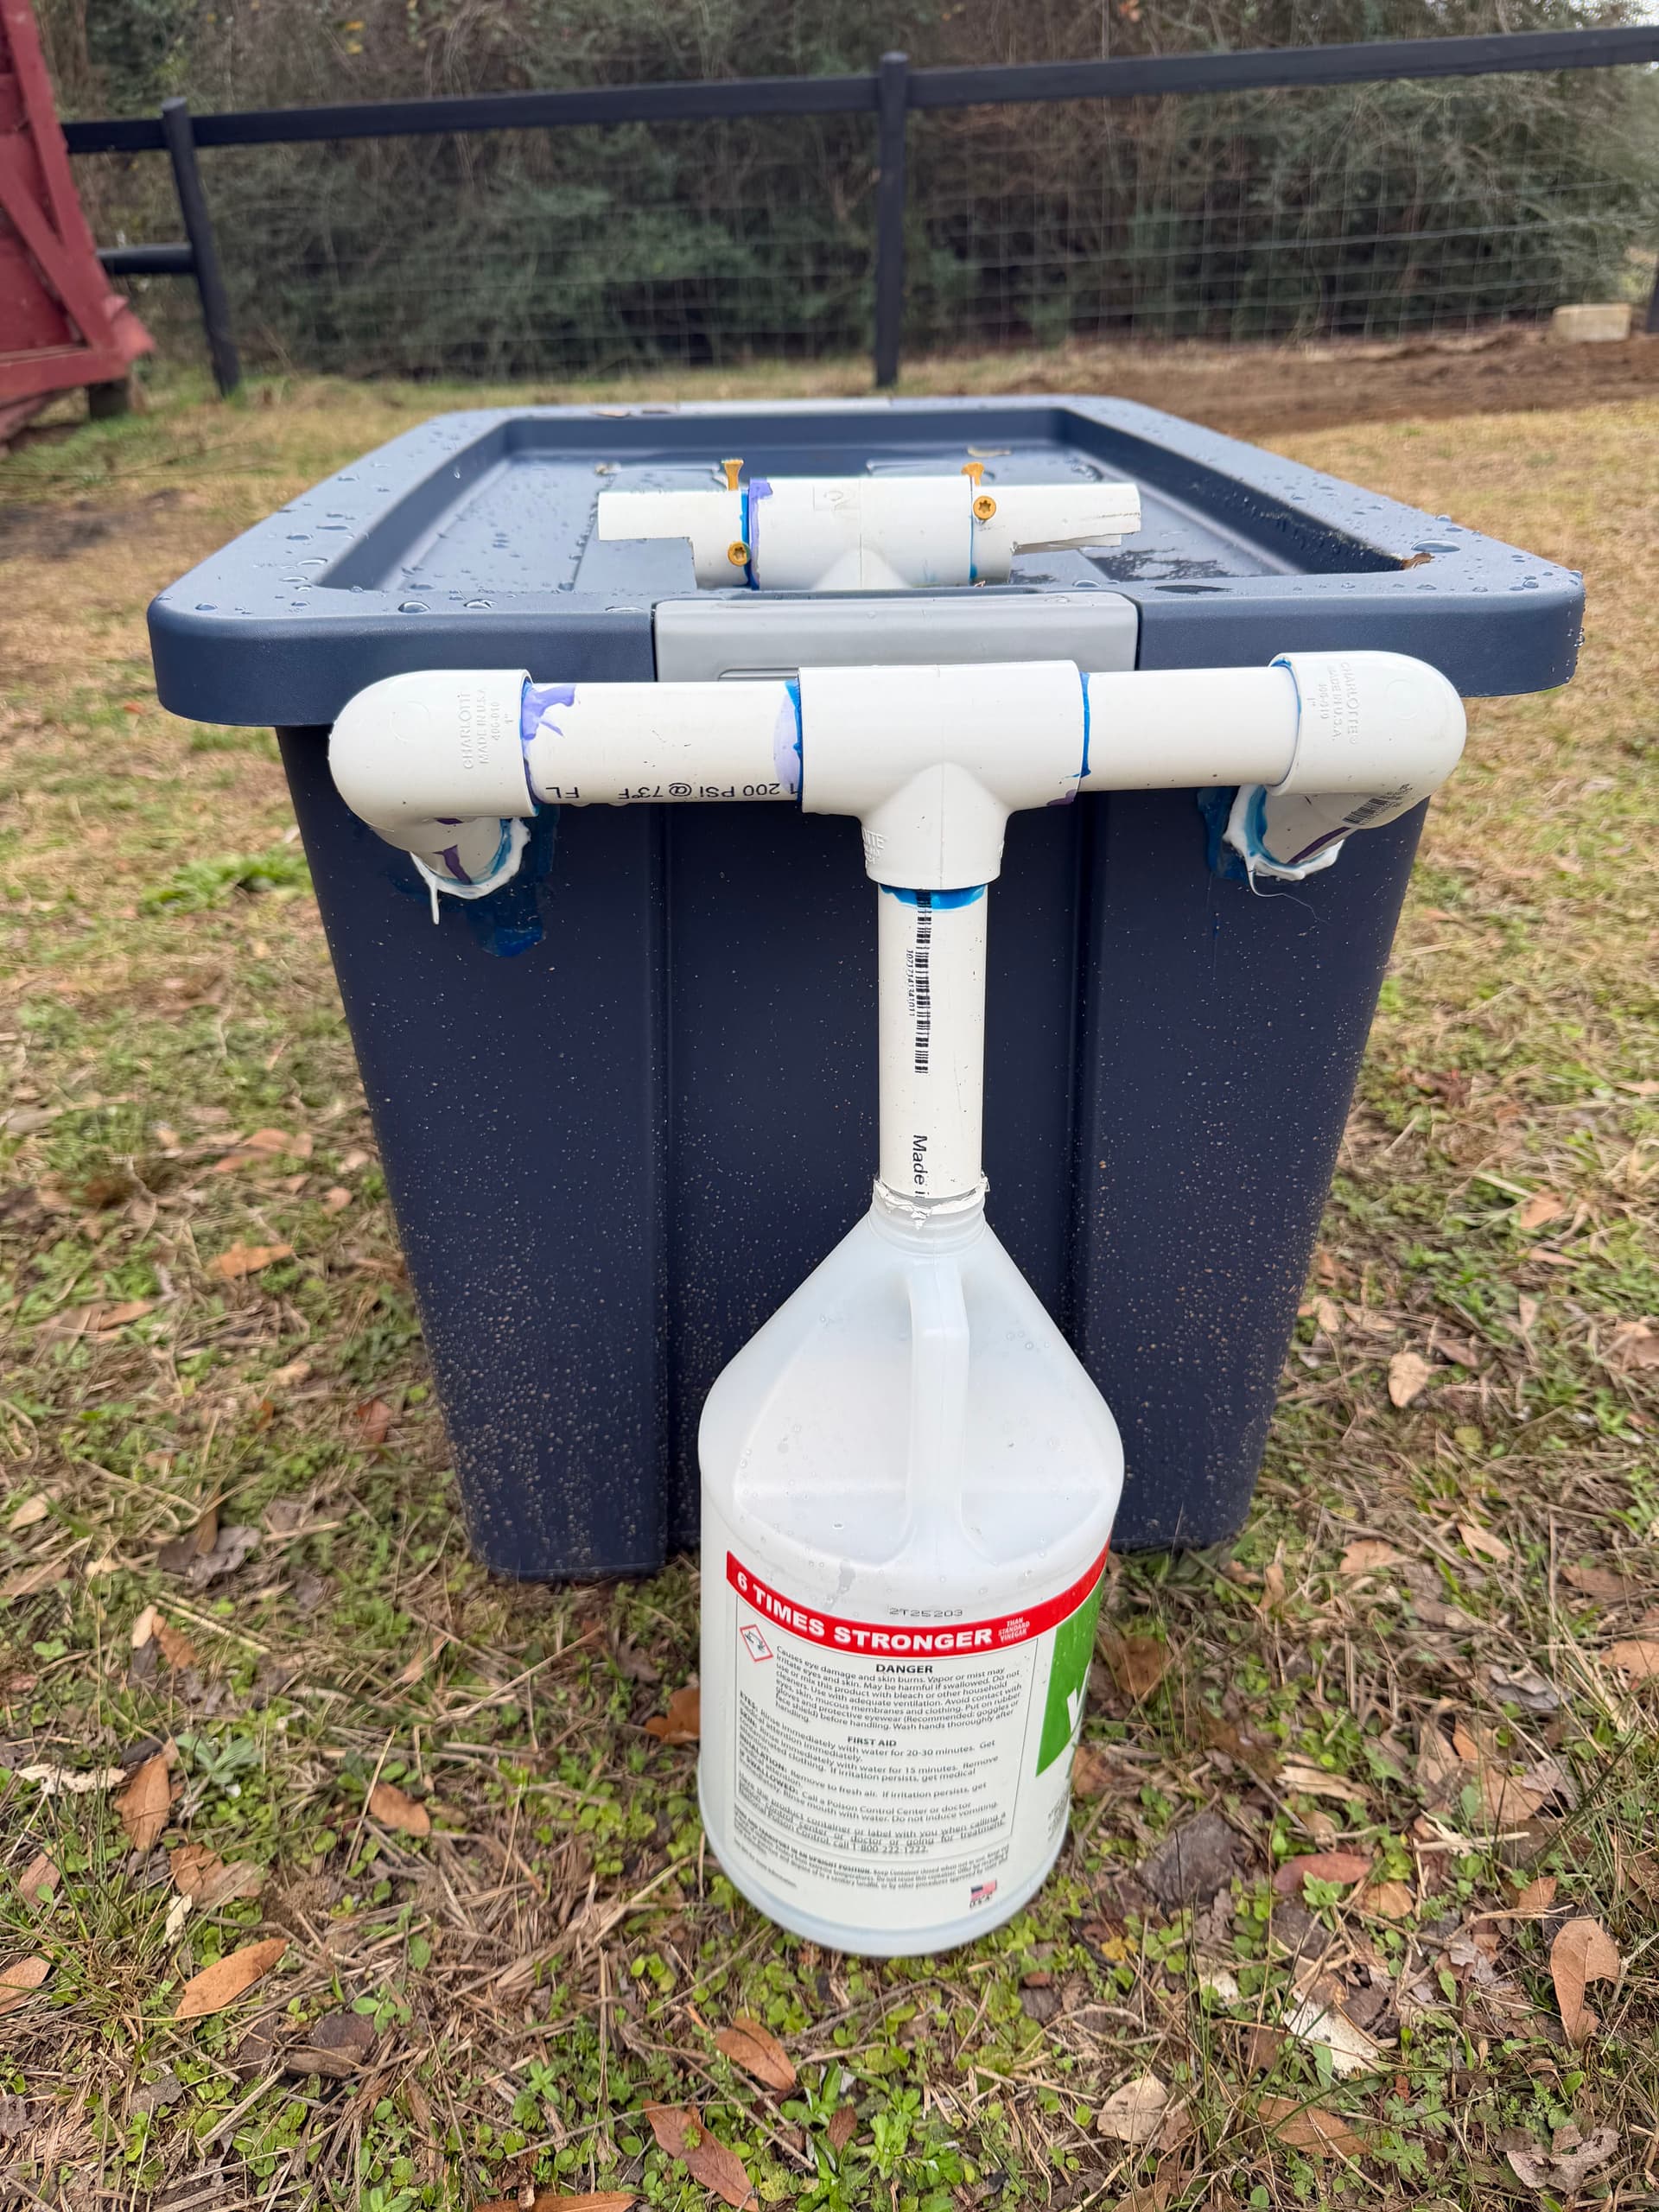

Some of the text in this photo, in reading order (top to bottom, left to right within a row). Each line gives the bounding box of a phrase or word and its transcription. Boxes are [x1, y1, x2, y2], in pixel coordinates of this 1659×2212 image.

[545, 786, 580, 799] FL
[669, 781, 692, 797] @
[742, 783, 781, 797] 200
[912, 1135, 928, 1185] Made
[737, 1571, 993, 1651] 6 TIMES STRONGER
[1007, 1617, 1024, 1627] THAN
[998, 1621, 1031, 1637] STANDARD
[1000, 1629, 1028, 1643] VINEGAR
[777, 1645, 803, 1664] Causes
[804, 1658, 819, 1670] eye
[821, 1665, 856, 1680] damage
[877, 1675, 895, 1683] skin
[927, 1675, 953, 1684] Vapor
[987, 1667, 1005, 1675] may
[875, 1663, 933, 1674] DANGER
[776, 1662, 790, 1674] use
[791, 1669, 799, 1678] or
[800, 1675, 816, 1685] mix
[817, 1681, 832, 1690] this
[835, 1685, 869, 1697] product
[937, 1690, 960, 1699] other
[963, 1681, 1007, 1695] household
[776, 1670, 1022, 1707] cleaners. Use with adequate ventilation. Avoid contact with
[803, 1668, 821, 1679] eyes
[823, 1675, 840, 1684] and
[841, 1679, 862, 1688] skin.
[863, 1681, 882, 1691] May
[898, 1683, 933, 1692] harmful
[943, 1677, 990, 1690] swallowed.
[992, 1675, 1004, 1683] Do
[1006, 1669, 1020, 1679] not
[775, 1686, 800, 1703] gloves
[801, 1700, 817, 1709] and
[818, 1706, 862, 1719] protective
[864, 1714, 901, 1723] eyewear
[904, 1710, 975, 1723] (Recommended:
[976, 1704, 1009, 1717] goggles
[776, 1678, 795, 1693] eyes,
[796, 1688, 813, 1701] skin,
[815, 1696, 849, 1709] mucous
[851, 1705, 904, 1715] membranes
[925, 1705, 963, 1715] clothing.
[965, 1702, 979, 1711] Put
[994, 1692, 1020, 1706] rubber
[791, 1702, 818, 1719] shield)
[820, 1713, 848, 1726] before
[849, 1719, 892, 1731] handling.
[947, 1713, 995, 1728] thoroughly
[995, 1709, 1014, 1719] after
[847, 1735, 876, 1745] FIRST
